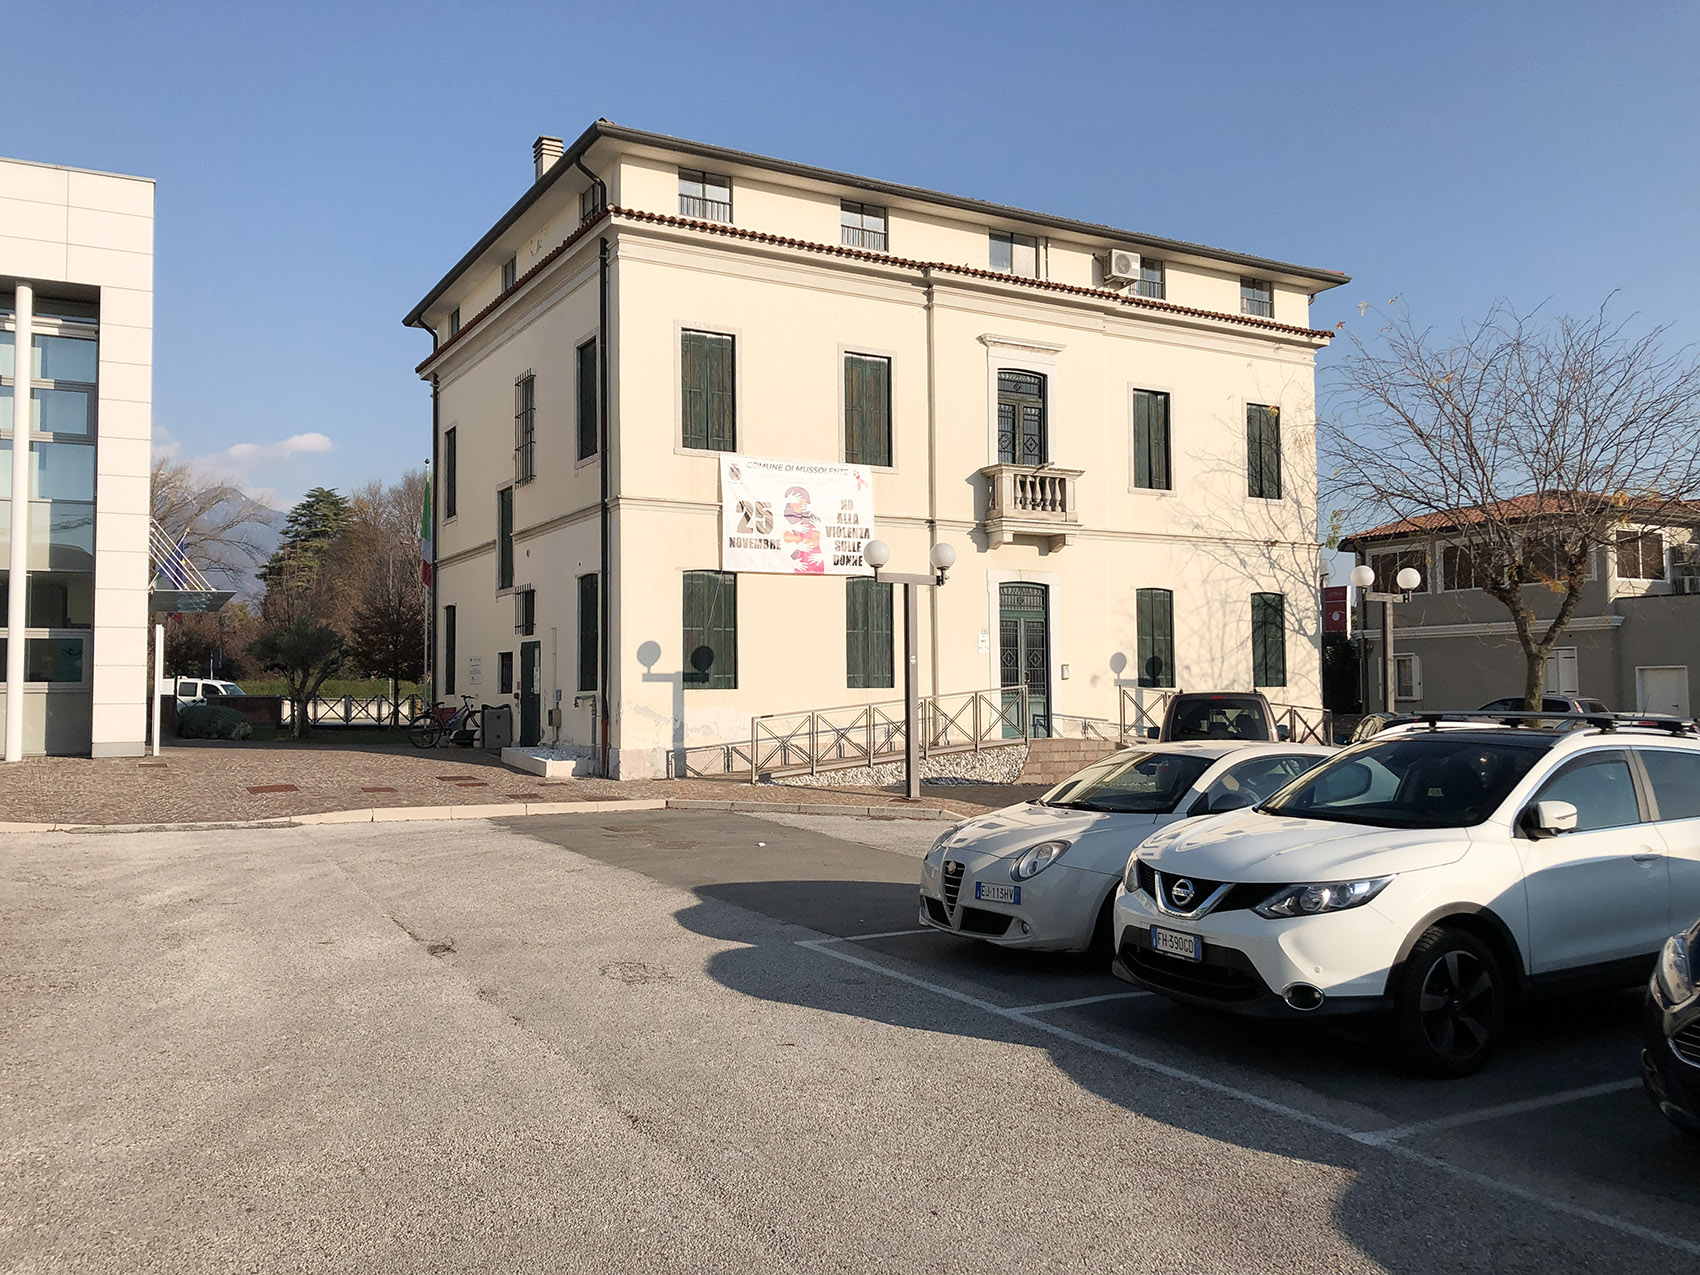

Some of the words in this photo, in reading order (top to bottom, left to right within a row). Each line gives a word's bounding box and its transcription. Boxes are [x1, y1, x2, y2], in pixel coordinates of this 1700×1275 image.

[746, 461, 783, 470] COMUNE
[785, 464, 794, 472] DI
[840, 499, 853, 510] NO
[736, 500, 773, 534] 25
[837, 512, 859, 525] ALLA
[825, 526, 870, 539] VIOLENZA
[729, 536, 781, 550] NOVEMBRE
[834, 540, 862, 552] SULLE
[833, 554, 863, 567] DONNE
